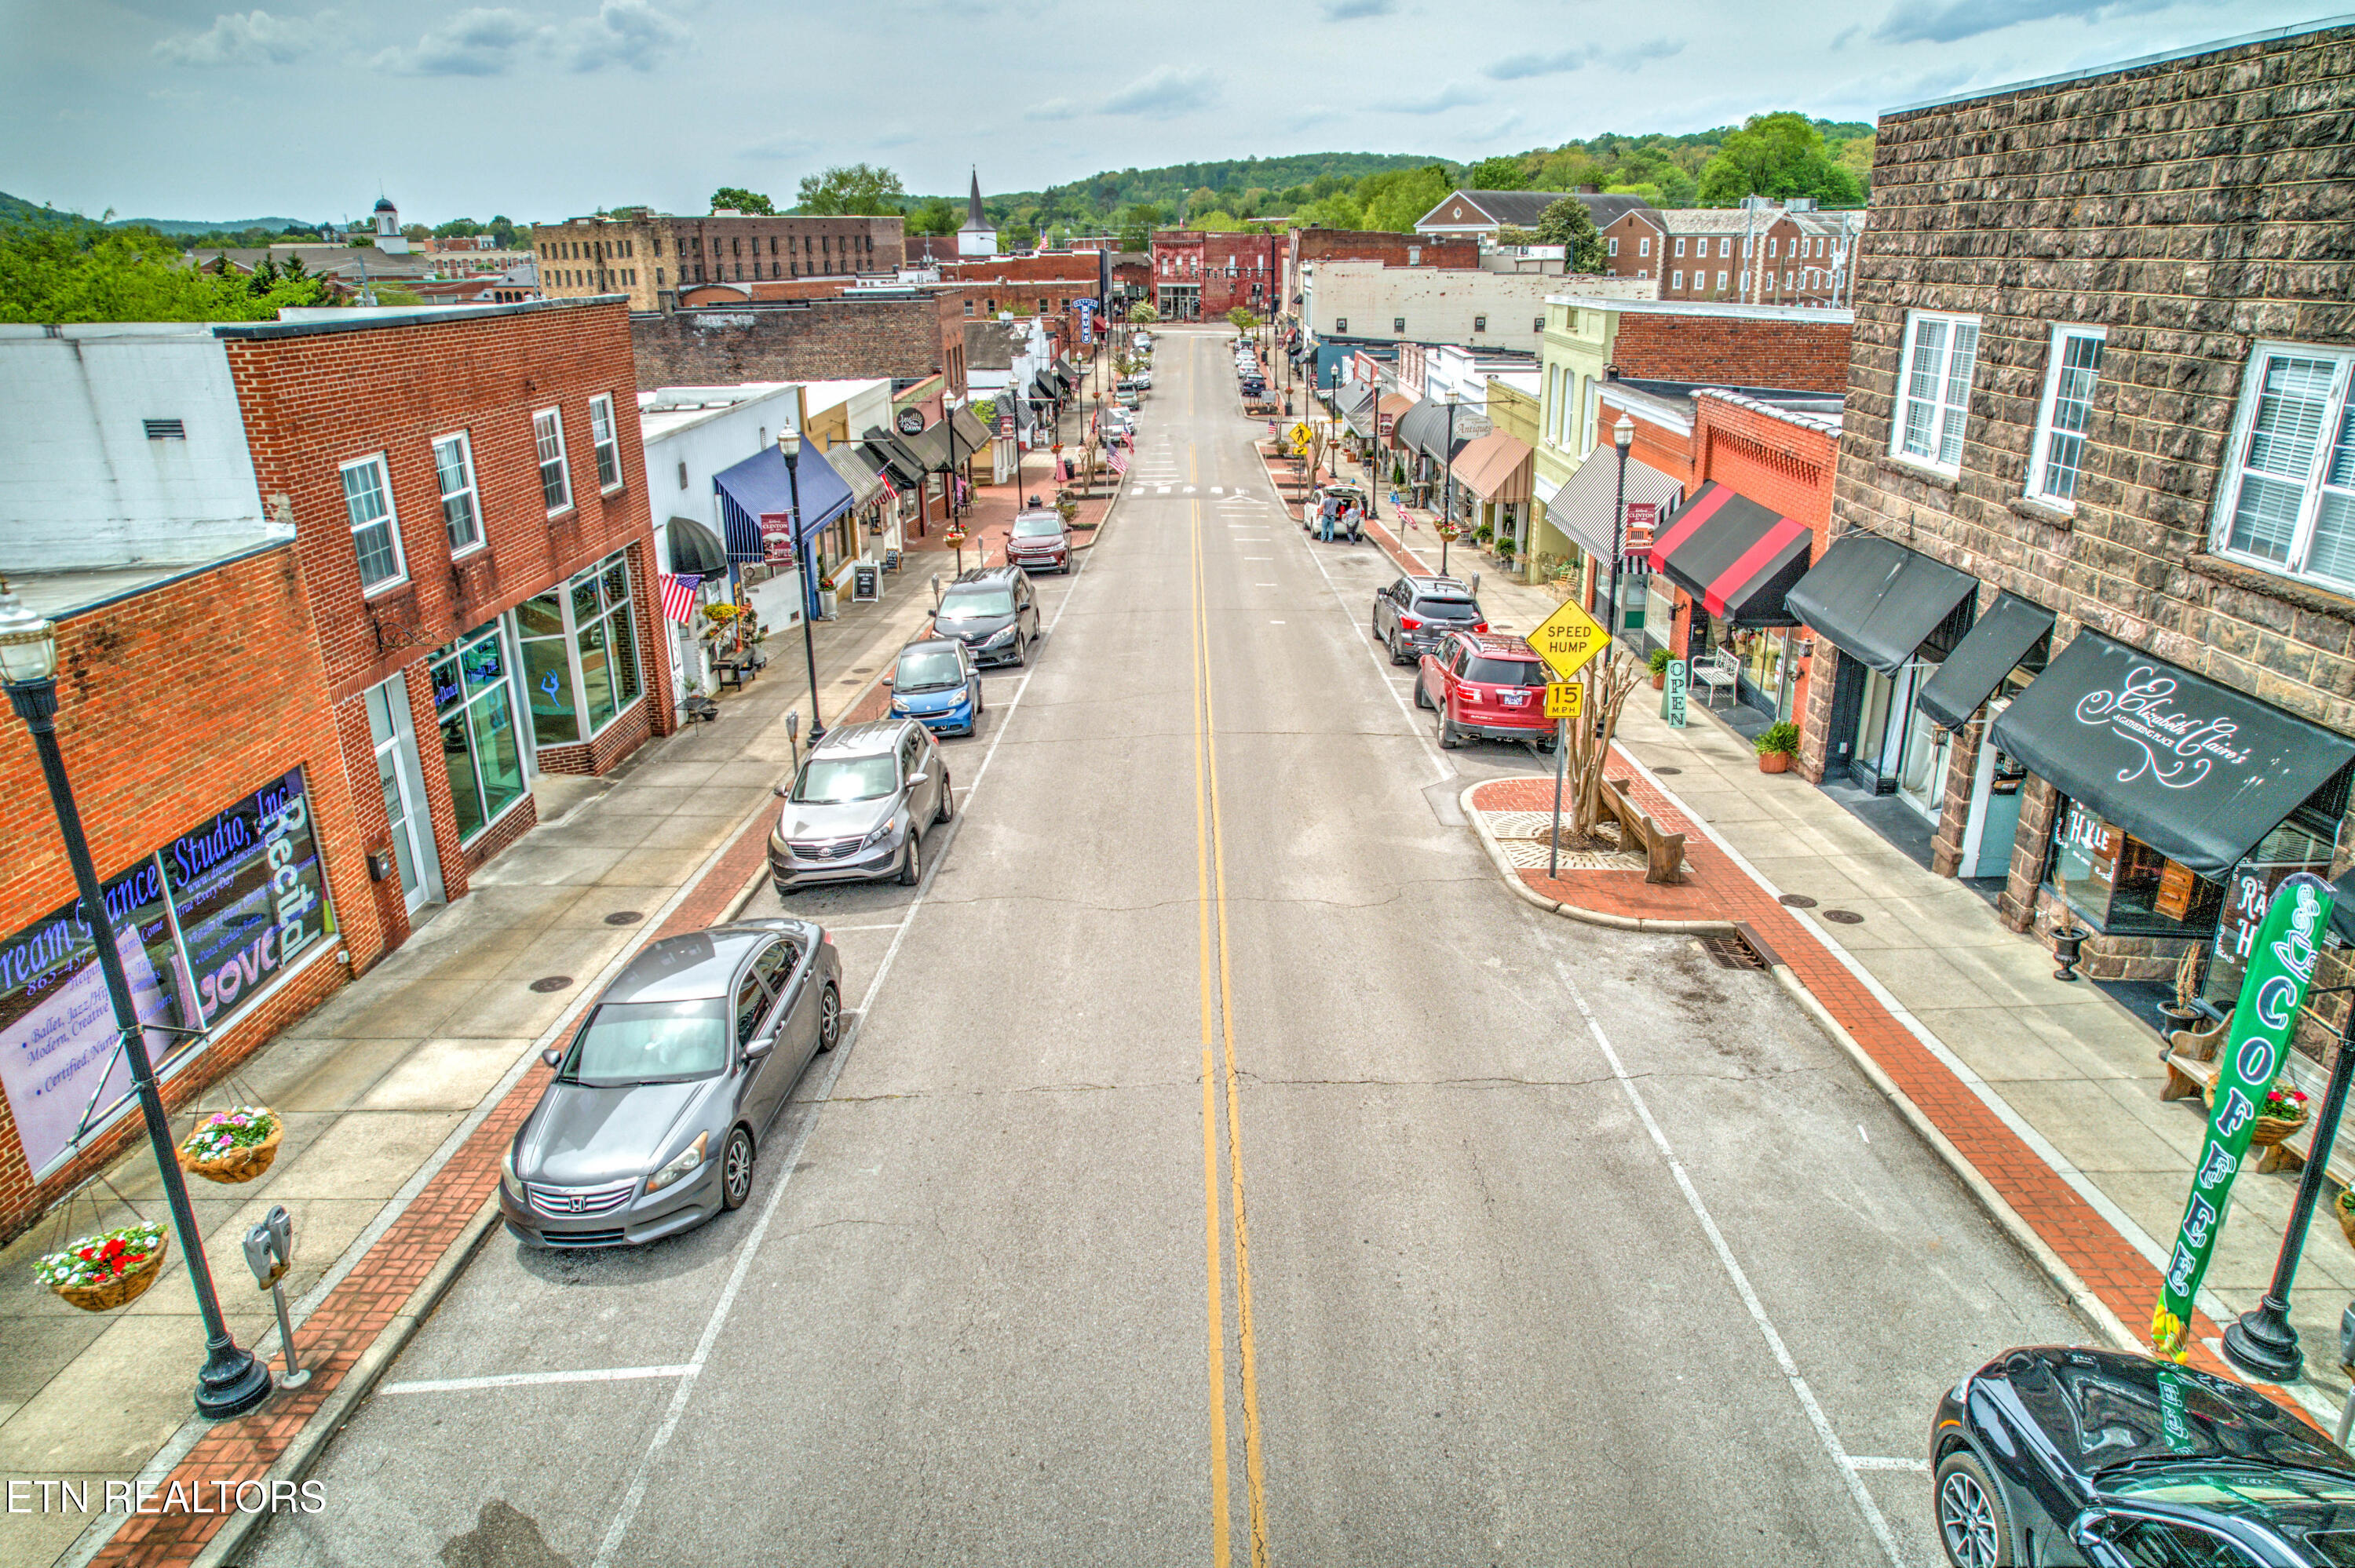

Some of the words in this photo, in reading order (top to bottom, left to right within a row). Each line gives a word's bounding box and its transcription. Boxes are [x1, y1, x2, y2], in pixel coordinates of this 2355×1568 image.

[1456, 424, 1492, 436] Antiques
[1548, 626, 1591, 637] SPEED
[1550, 642, 1587, 653] HUMP
[1555, 687, 1578, 704] 15
[1670, 662, 1685, 725] OPEN
[2105, 666, 2203, 736] Elizabeth
[2174, 717, 2252, 764] Claire's
[2119, 716, 2155, 738] GATHERING
[2153, 732, 2176, 748] PLACE
[0, 919, 75, 990] ream
[175, 809, 250, 888] Studio,
[254, 793, 321, 968] Recital
[141, 920, 163, 942] Come
[177, 903, 195, 918] True
[195, 886, 217, 906] Every
[27, 1033, 70, 1067] Modern,
[71, 1003, 109, 1037] Creative
[31, 1016, 64, 1044] Ballet,
[45, 1049, 91, 1093] Certified,
[2167, 975, 2298, 1299] COFFEE
